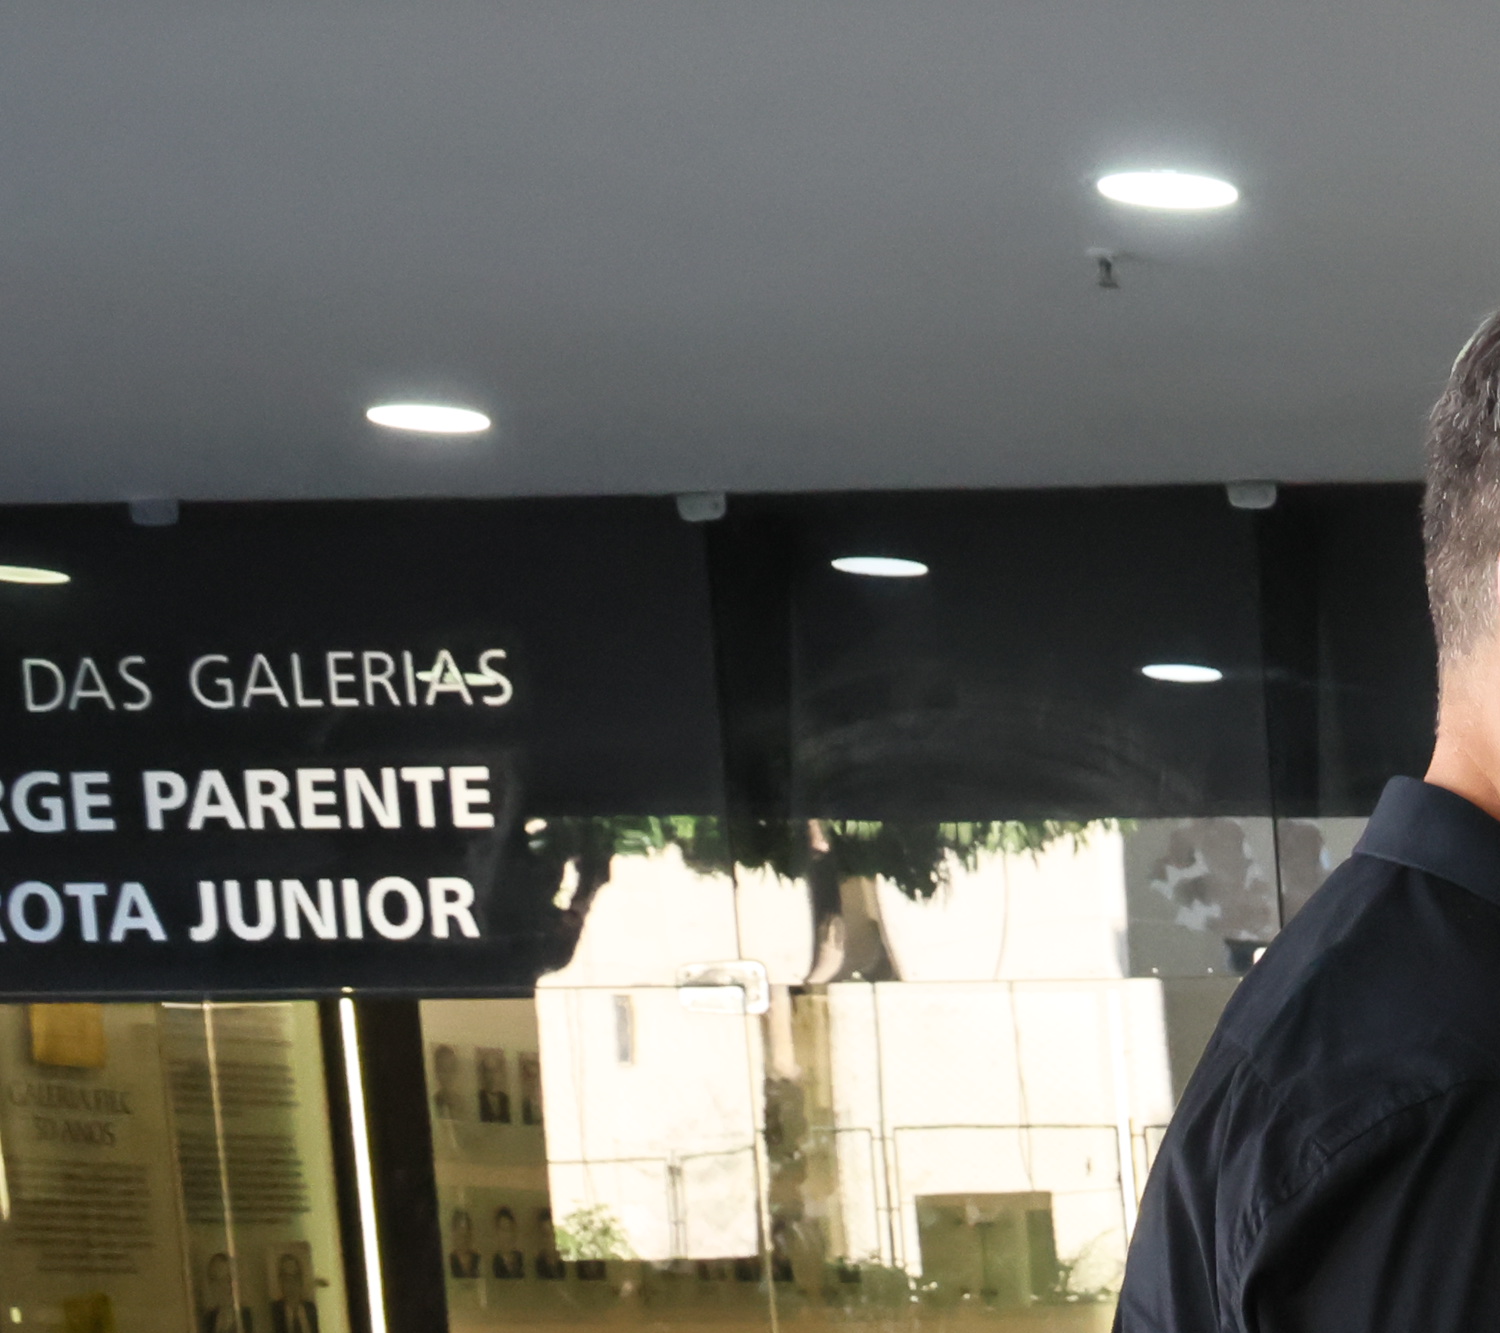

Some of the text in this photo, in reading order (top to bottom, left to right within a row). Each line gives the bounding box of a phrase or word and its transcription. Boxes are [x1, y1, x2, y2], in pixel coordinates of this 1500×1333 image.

[21, 649, 514, 714] DAS GALERIAS
[142, 766, 495, 831] PARENTE
[0, 877, 481, 943] OTA JUNIOR
